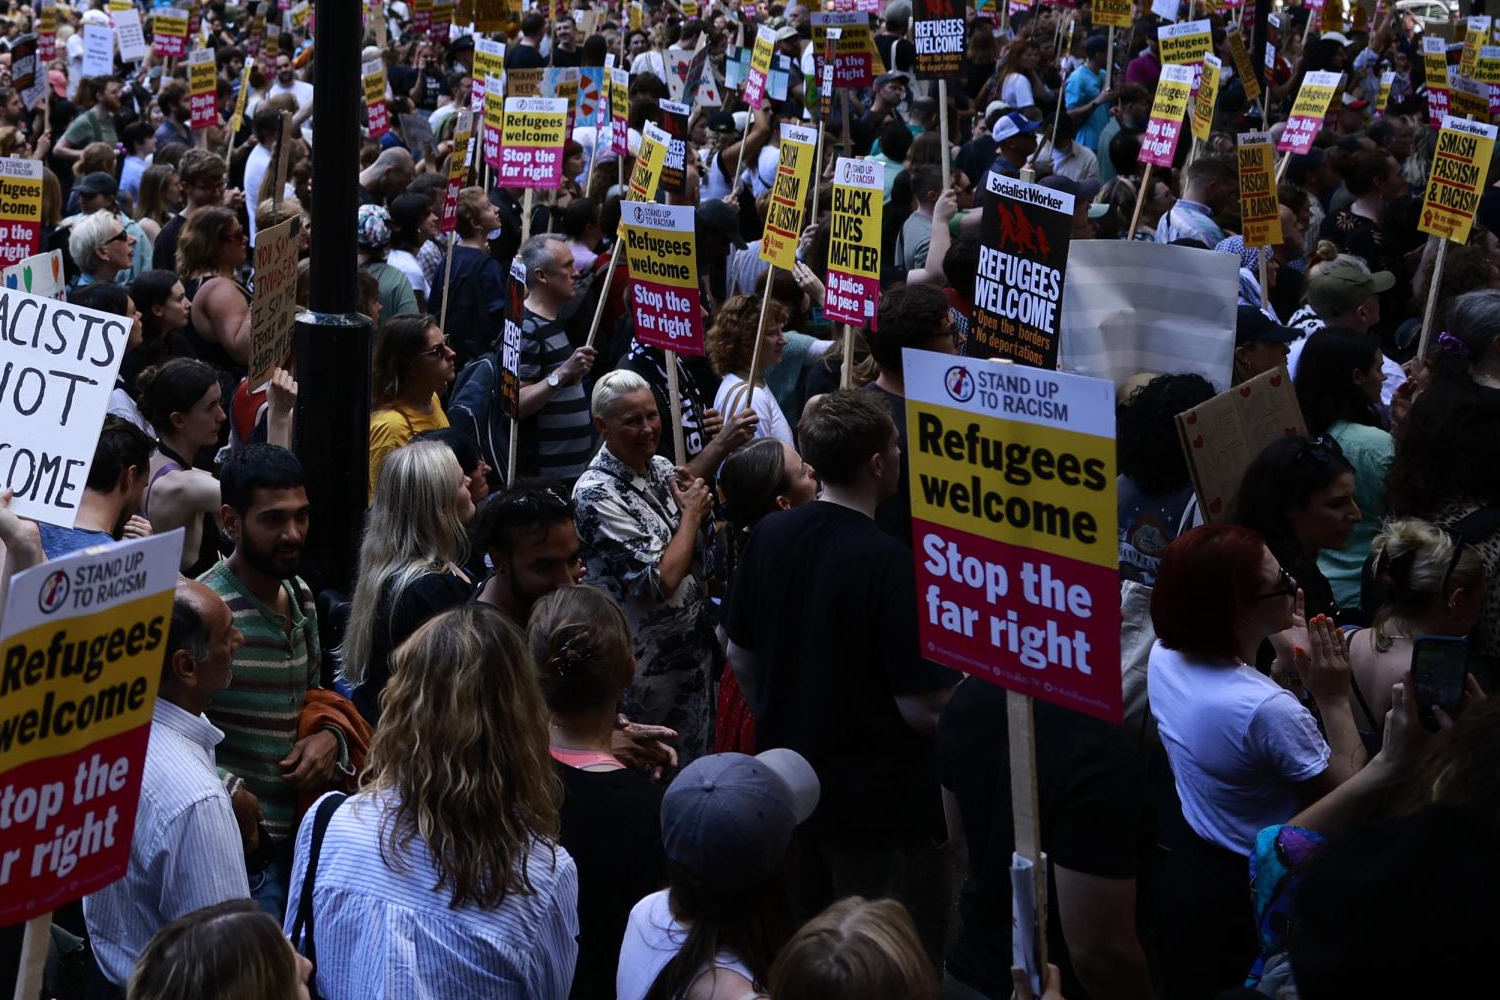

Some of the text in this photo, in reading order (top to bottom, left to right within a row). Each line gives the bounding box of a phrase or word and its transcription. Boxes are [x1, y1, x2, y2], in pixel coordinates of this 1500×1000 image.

[914, 18, 965, 38] REFUGEES
[914, 35, 964, 55] WELCOME
[1162, 36, 1210, 50] Refugees
[1164, 49, 1206, 61] welcome
[845, 55, 865, 66] the
[509, 71, 544, 81] MIGRANTS
[837, 67, 865, 81] right
[515, 83, 535, 92] KEEP
[1157, 83, 1190, 101] Refugees
[1301, 86, 1332, 101] Refugees
[1153, 101, 1183, 116] welcome
[1295, 102, 1325, 114] welcome
[506, 114, 563, 130] Refugees
[1145, 119, 1176, 139] Stop the
[1286, 116, 1316, 131] Stop the
[505, 130, 560, 143] welcome
[1151, 139, 1172, 156] right
[1290, 132, 1311, 146] right
[1439, 132, 1478, 159] SMASH
[503, 149, 556, 165] Stop the
[502, 163, 554, 182] far right
[1433, 157, 1481, 187] FASCISM
[834, 187, 872, 218] BLACK
[1242, 199, 1249, 218] &
[1428, 182, 1480, 213] & RACISM
[643, 207, 672, 219] STAND UP
[653, 217, 676, 229] RACISM
[768, 202, 776, 224] &
[11, 223, 33, 240] the
[832, 214, 864, 243] LIVES
[257, 243, 272, 269] YOU
[627, 229, 692, 258] Refugees
[630, 255, 691, 281] welcome
[830, 239, 879, 274] MATTER
[257, 252, 296, 298] INVADERS
[828, 272, 865, 296] No justice
[976, 244, 1061, 302] REFUGEES
[633, 283, 692, 313] Stop the
[826, 289, 859, 312] No peace
[974, 275, 1057, 335] WELCOME
[636, 307, 693, 339] far right
[977, 309, 1051, 351] Open the borders
[975, 326, 1044, 366] No deportations
[977, 370, 1060, 400] STAND UP
[978, 389, 1068, 422] TO RACISM
[918, 411, 1107, 492] Refugees
[918, 473, 1098, 544] welcome
[74, 551, 144, 587] STAND UP
[922, 532, 1093, 620] Stop the
[73, 570, 148, 609] TO RACISM
[925, 584, 1093, 676] far right
[0, 615, 165, 698] Refugees
[72, 752, 130, 807] the
[29, 803, 120, 879] right
